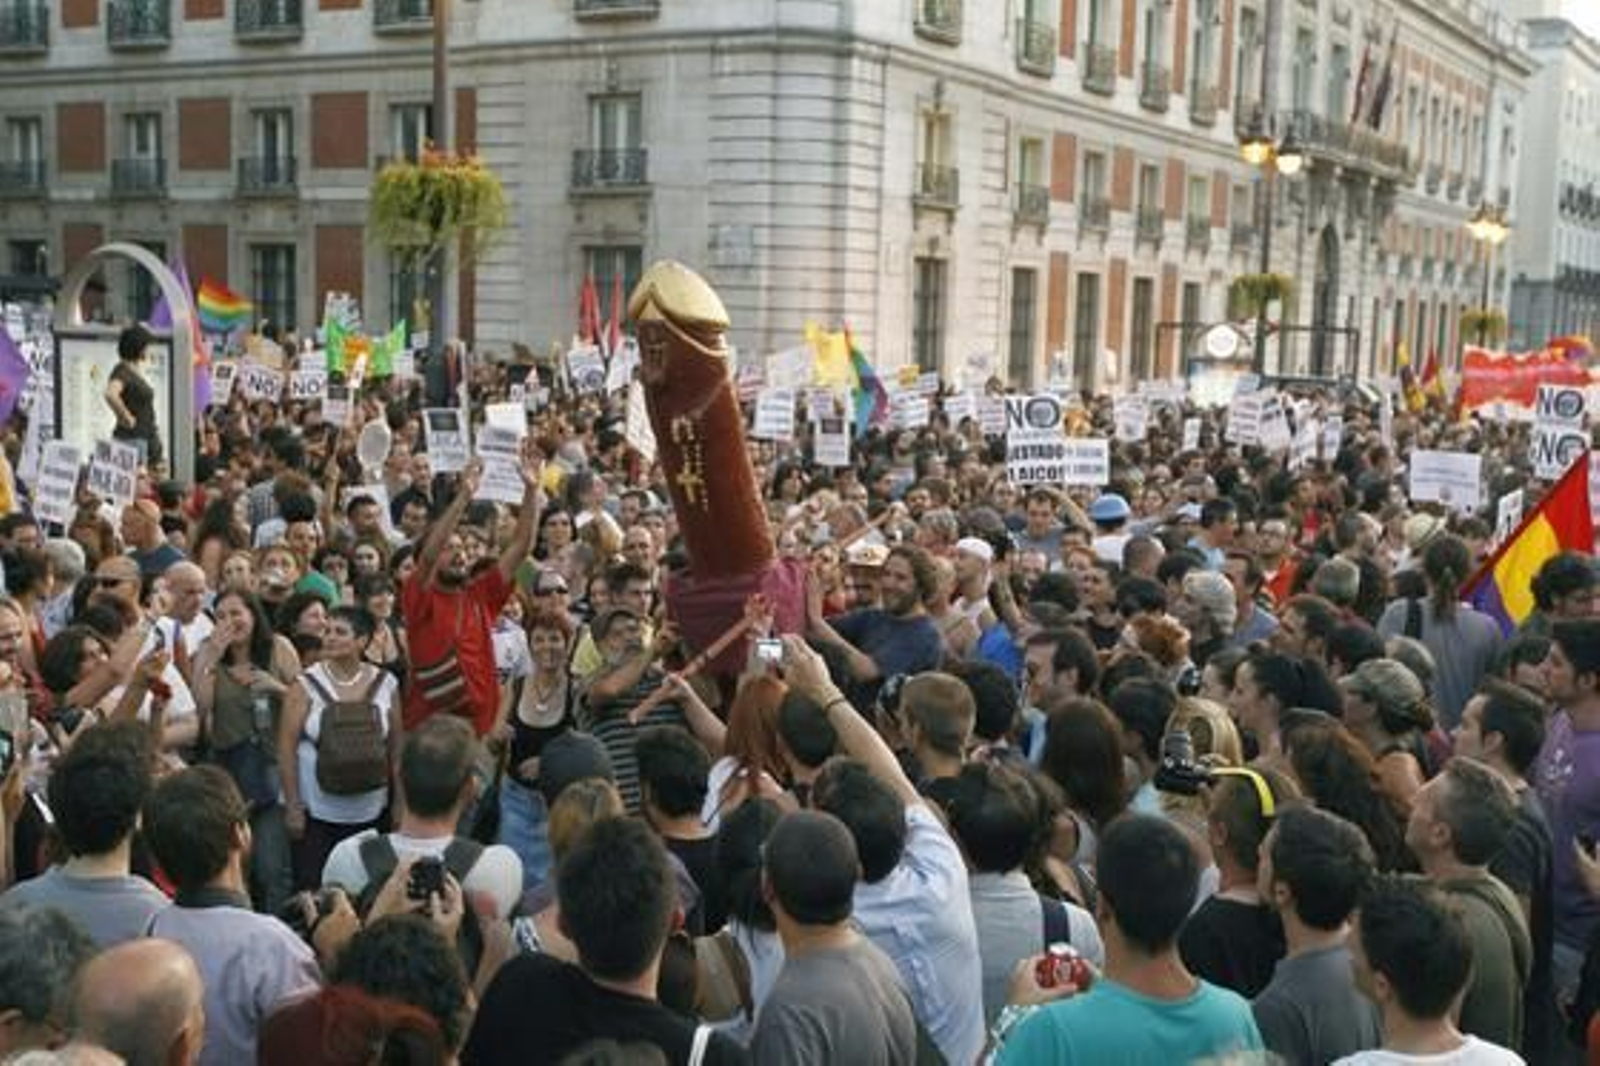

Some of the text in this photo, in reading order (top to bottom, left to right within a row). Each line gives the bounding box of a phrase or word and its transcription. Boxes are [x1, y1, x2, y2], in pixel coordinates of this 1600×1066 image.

[293, 379, 320, 395] NO
[1537, 387, 1584, 417] NO
[1005, 398, 1060, 428] NO
